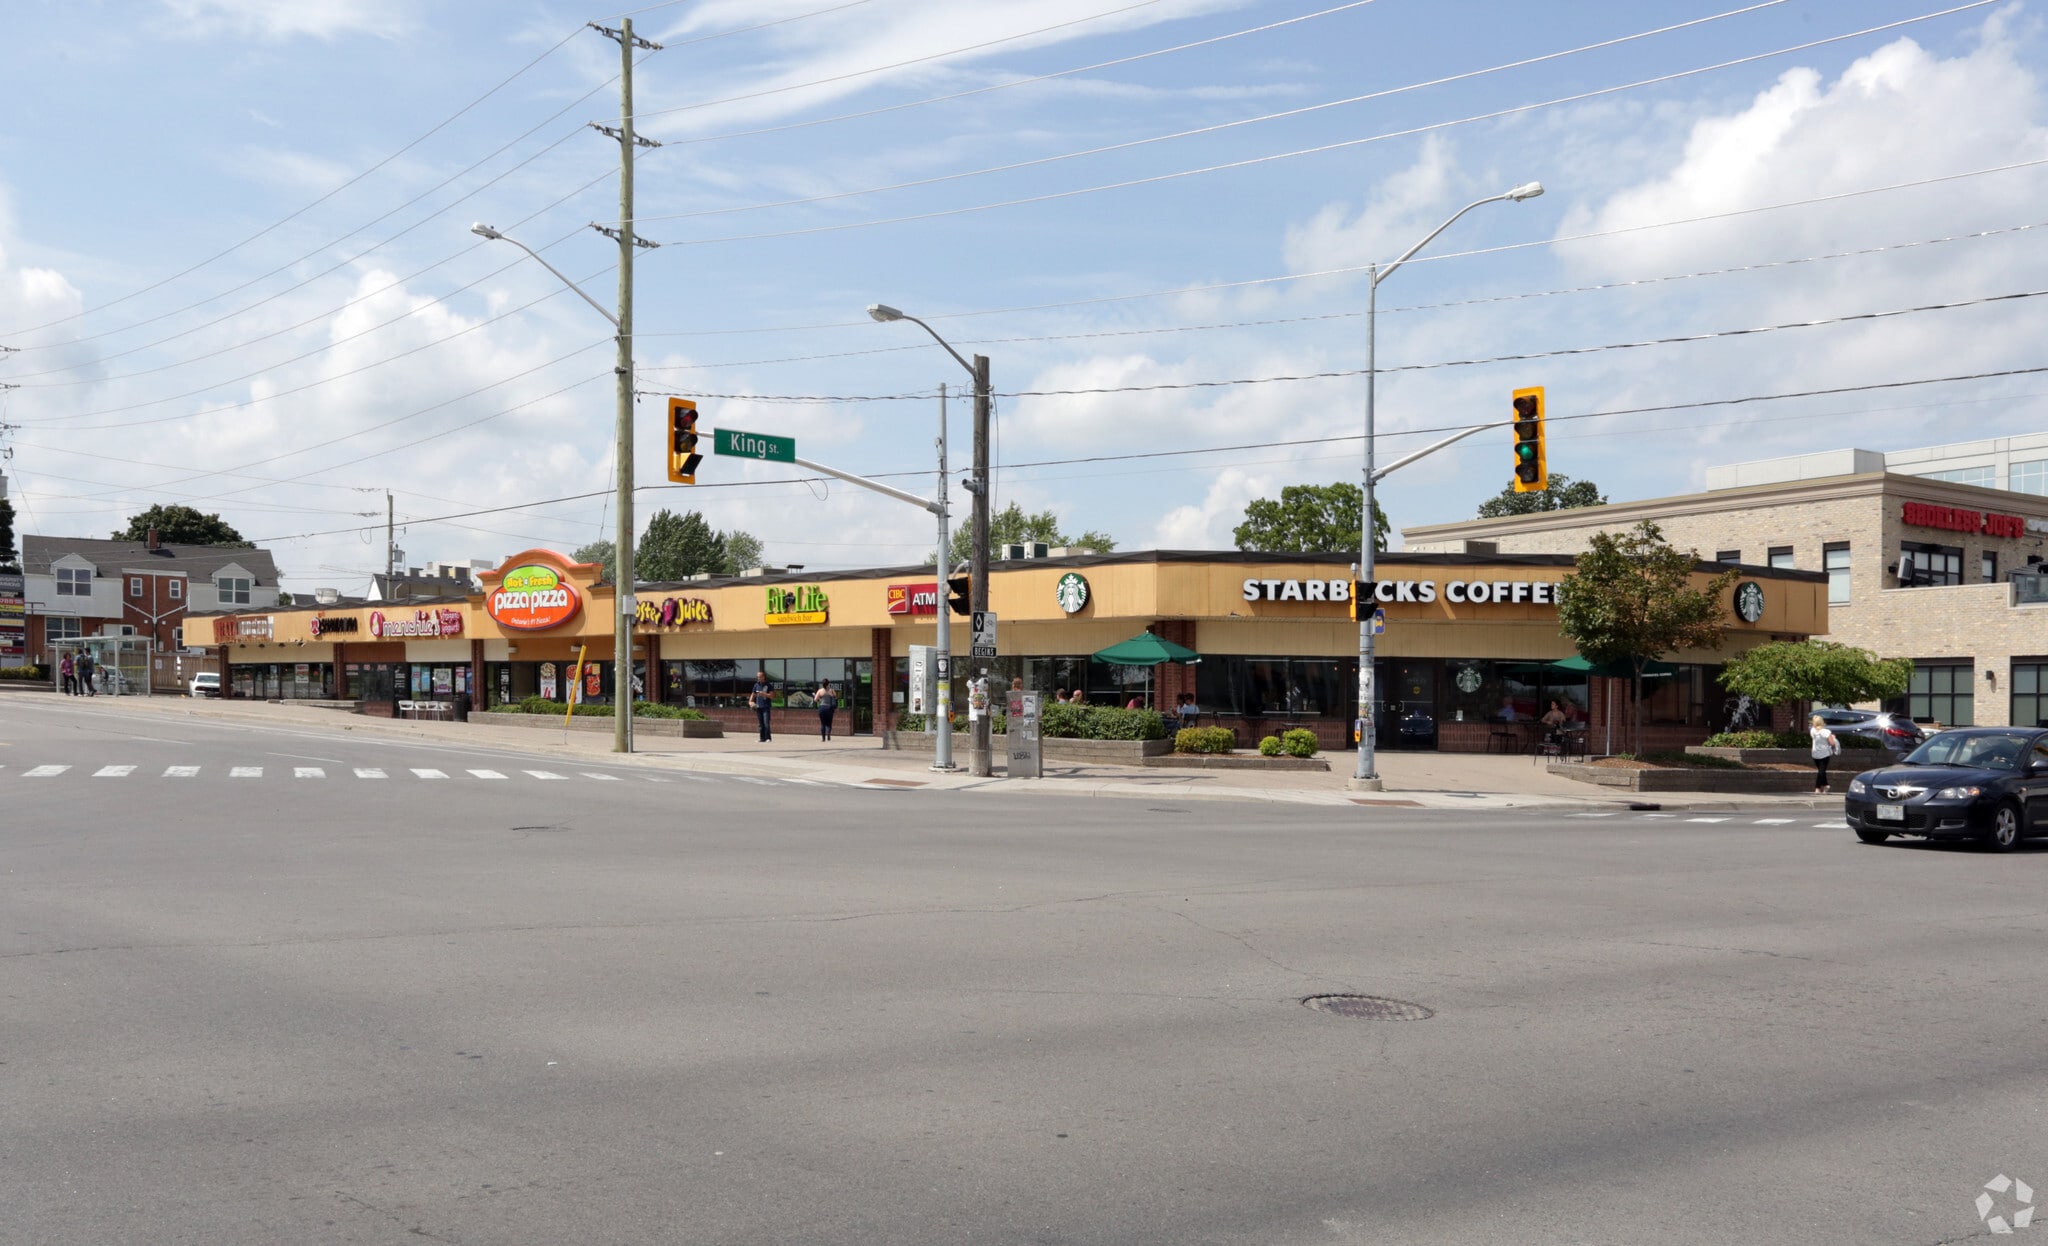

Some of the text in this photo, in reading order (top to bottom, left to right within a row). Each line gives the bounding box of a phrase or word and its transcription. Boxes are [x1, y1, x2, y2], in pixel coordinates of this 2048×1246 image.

[731, 433, 766, 459] King
[507, 577, 523, 588] Hot
[529, 574, 553, 586] Fresh
[1243, 579, 1437, 603] STARBCKS
[494, 589, 568, 616] pizza pizza
[766, 585, 828, 614] Fit Life
[889, 589, 936, 606] CIBC ATM
[675, 598, 709, 625] Juice
[974, 648, 994, 656] BEGINS
